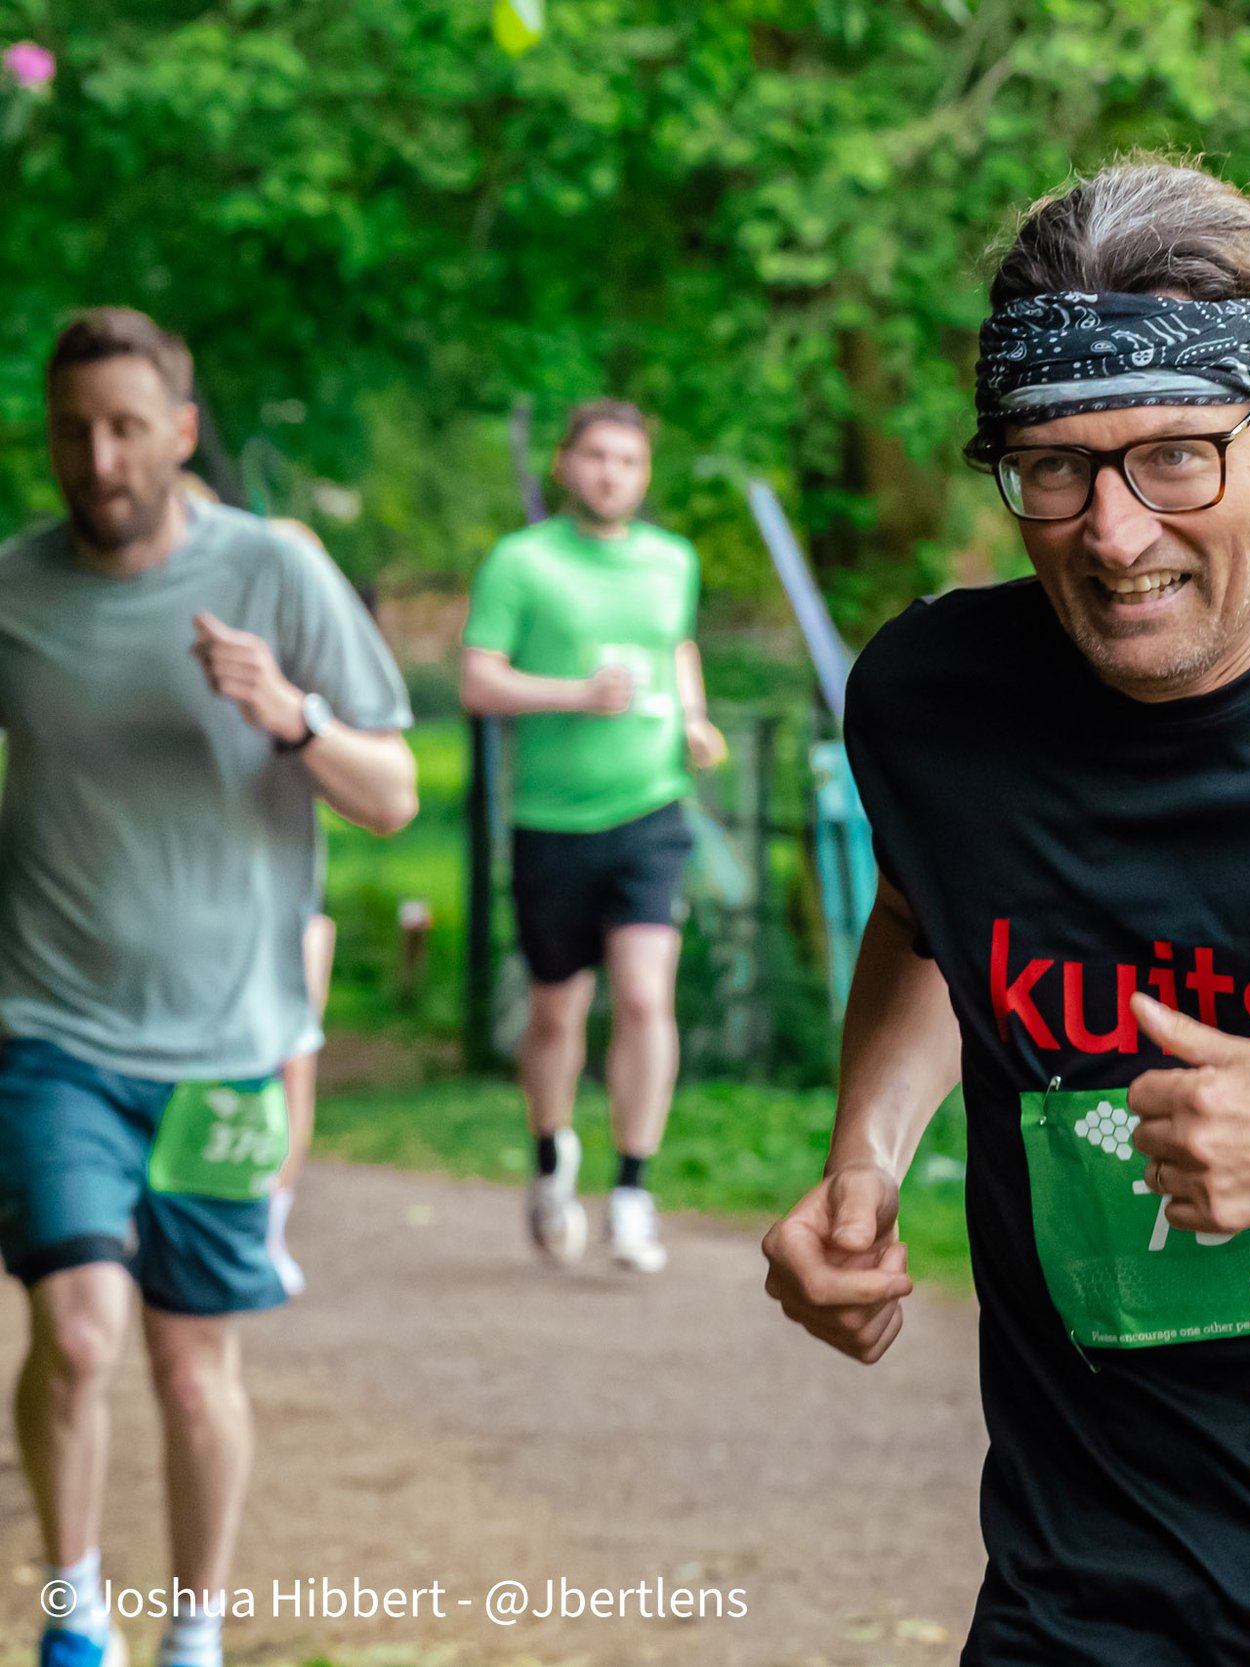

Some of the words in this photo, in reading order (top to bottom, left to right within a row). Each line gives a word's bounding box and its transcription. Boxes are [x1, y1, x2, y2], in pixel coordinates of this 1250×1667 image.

[1132, 1180, 1235, 1251] 7
[1091, 1330, 1118, 1342] Please
[1120, 1329, 1177, 1342] encourage
[1180, 1326, 1201, 1337] one
[1203, 1321, 1234, 1335] other
